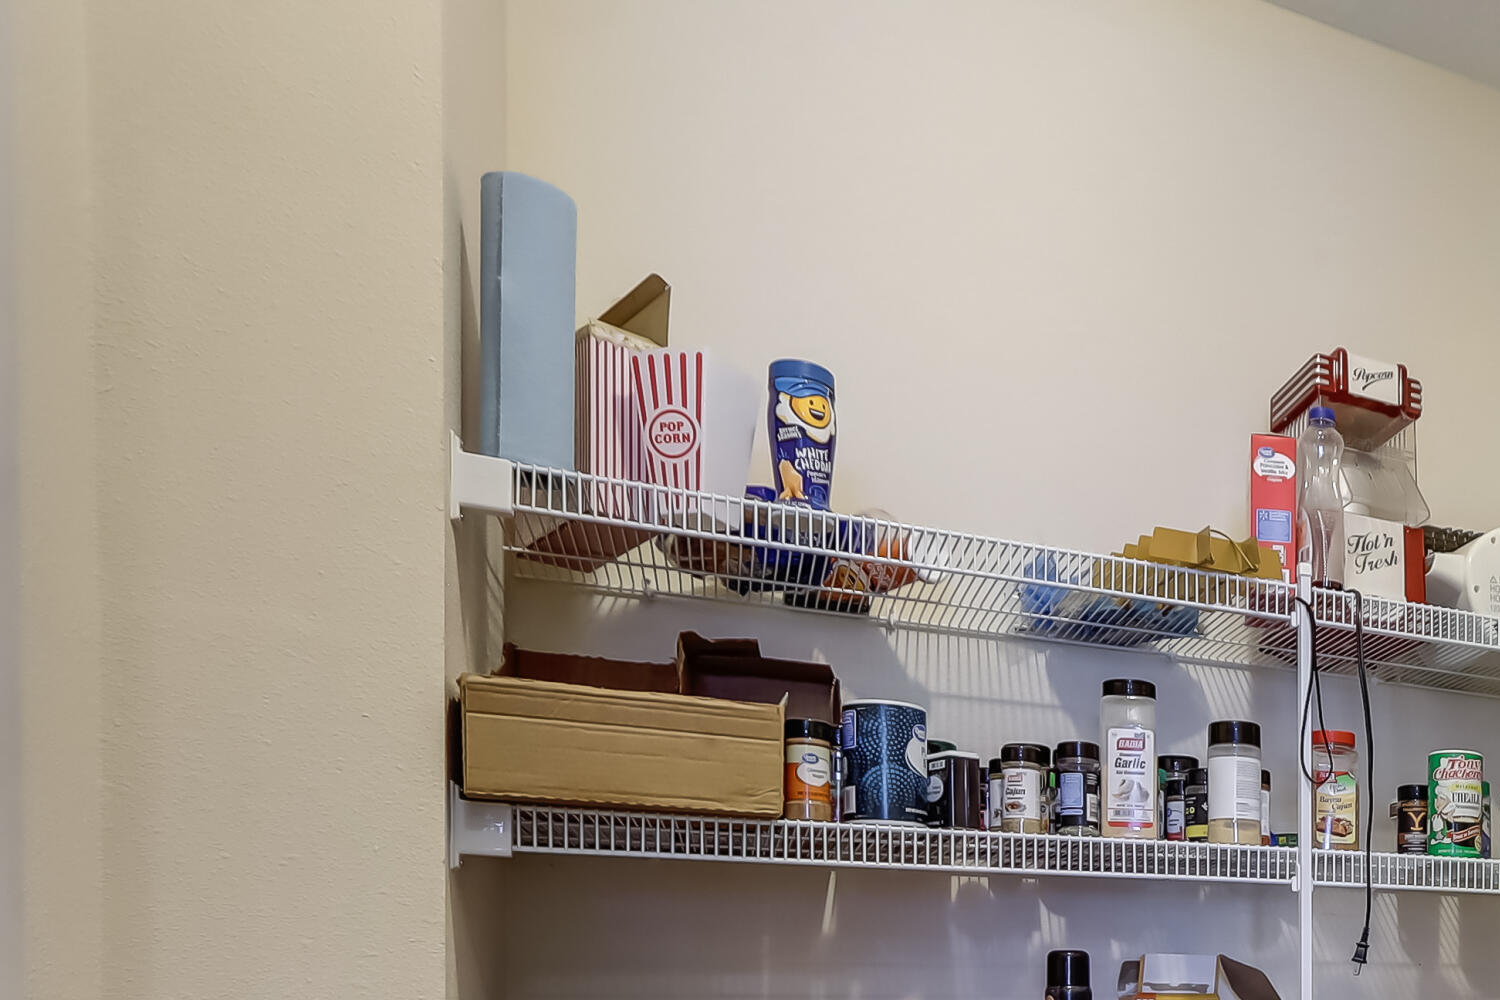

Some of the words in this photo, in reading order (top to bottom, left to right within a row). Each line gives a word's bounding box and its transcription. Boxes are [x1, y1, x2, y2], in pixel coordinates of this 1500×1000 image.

[1352, 367, 1393, 384] Popcorn
[659, 421, 684, 432] POP
[654, 432, 691, 444] CORN
[794, 447, 829, 462] WHITE
[1347, 531, 1379, 554] Hot
[1354, 550, 1398, 575] Fresh
[1117, 738, 1144, 750] BADIA
[1114, 756, 1147, 770] Garlic
